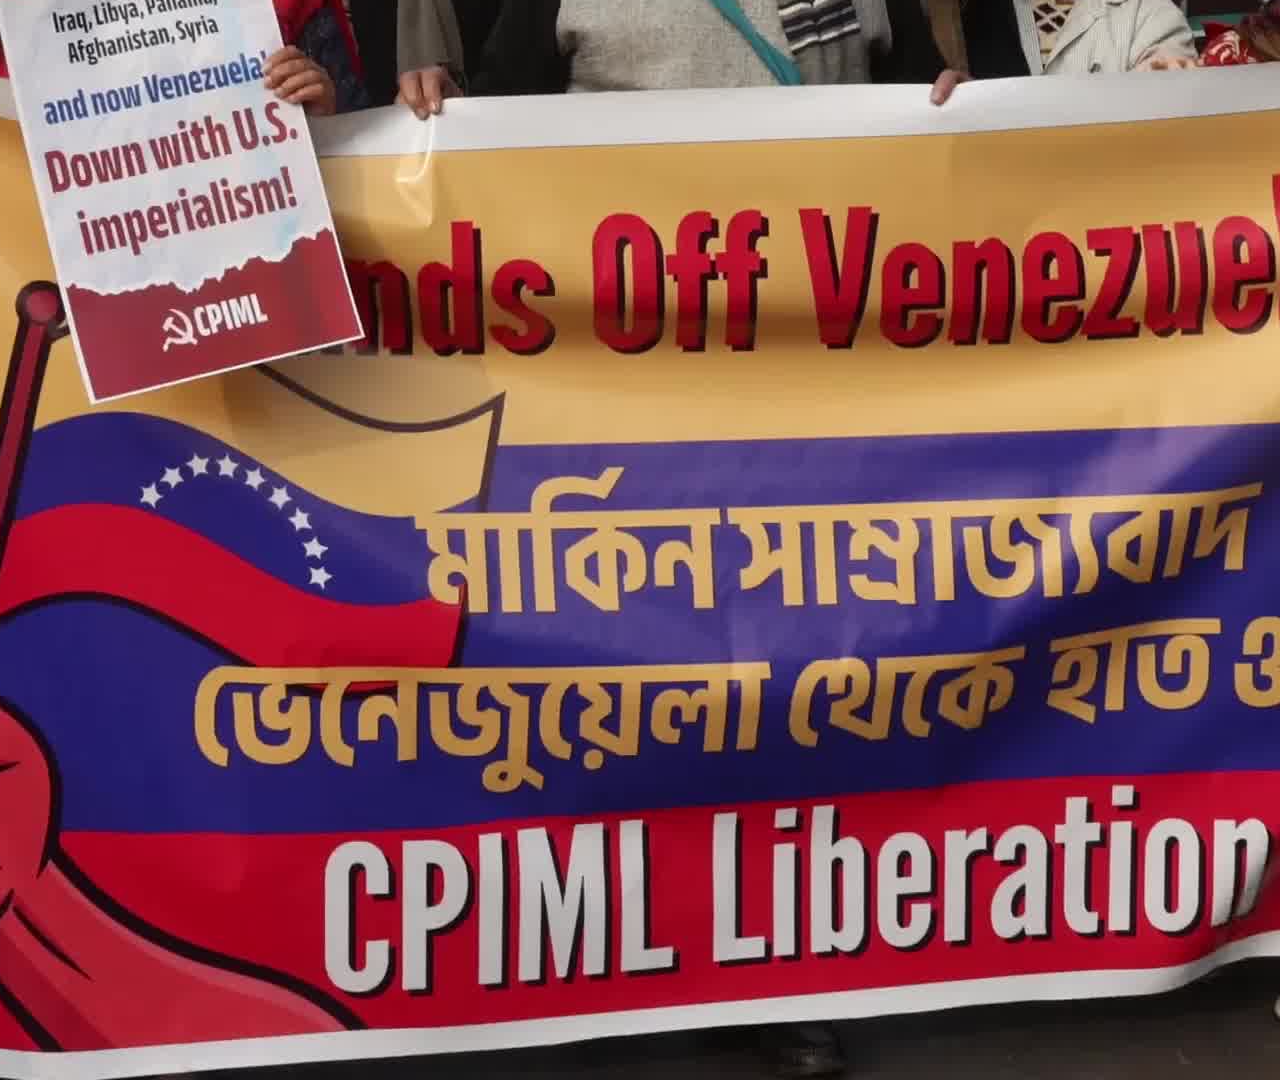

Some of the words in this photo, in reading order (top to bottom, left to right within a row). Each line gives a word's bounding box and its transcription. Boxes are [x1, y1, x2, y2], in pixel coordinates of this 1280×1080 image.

[52, 0, 94, 36] Iraq,
[66, 26, 176, 65] Afghanistan,
[175, 15, 220, 45] Syria
[43, 91, 89, 126] and
[90, 82, 143, 118] now
[143, 49, 271, 106] Venezuela
[44, 138, 148, 194] Down
[149, 114, 232, 170] with
[231, 101, 299, 151] U.S.
[76, 166, 298, 257] imperialism!
[193, 293, 269, 338] CPIML
[346, 220, 555, 356] nds
[592, 209, 769, 354] Off
[414, 467, 723, 614] মার্কিন
[725, 483, 1264, 606] সাম্রাজ্যবাদ
[193, 661, 776, 796] ভেনেজুয়েলা
[786, 646, 1025, 747] থেকে
[1046, 617, 1223, 722] হাত
[323, 818, 678, 998] CPIML
[711, 783, 1273, 965] Liberation
